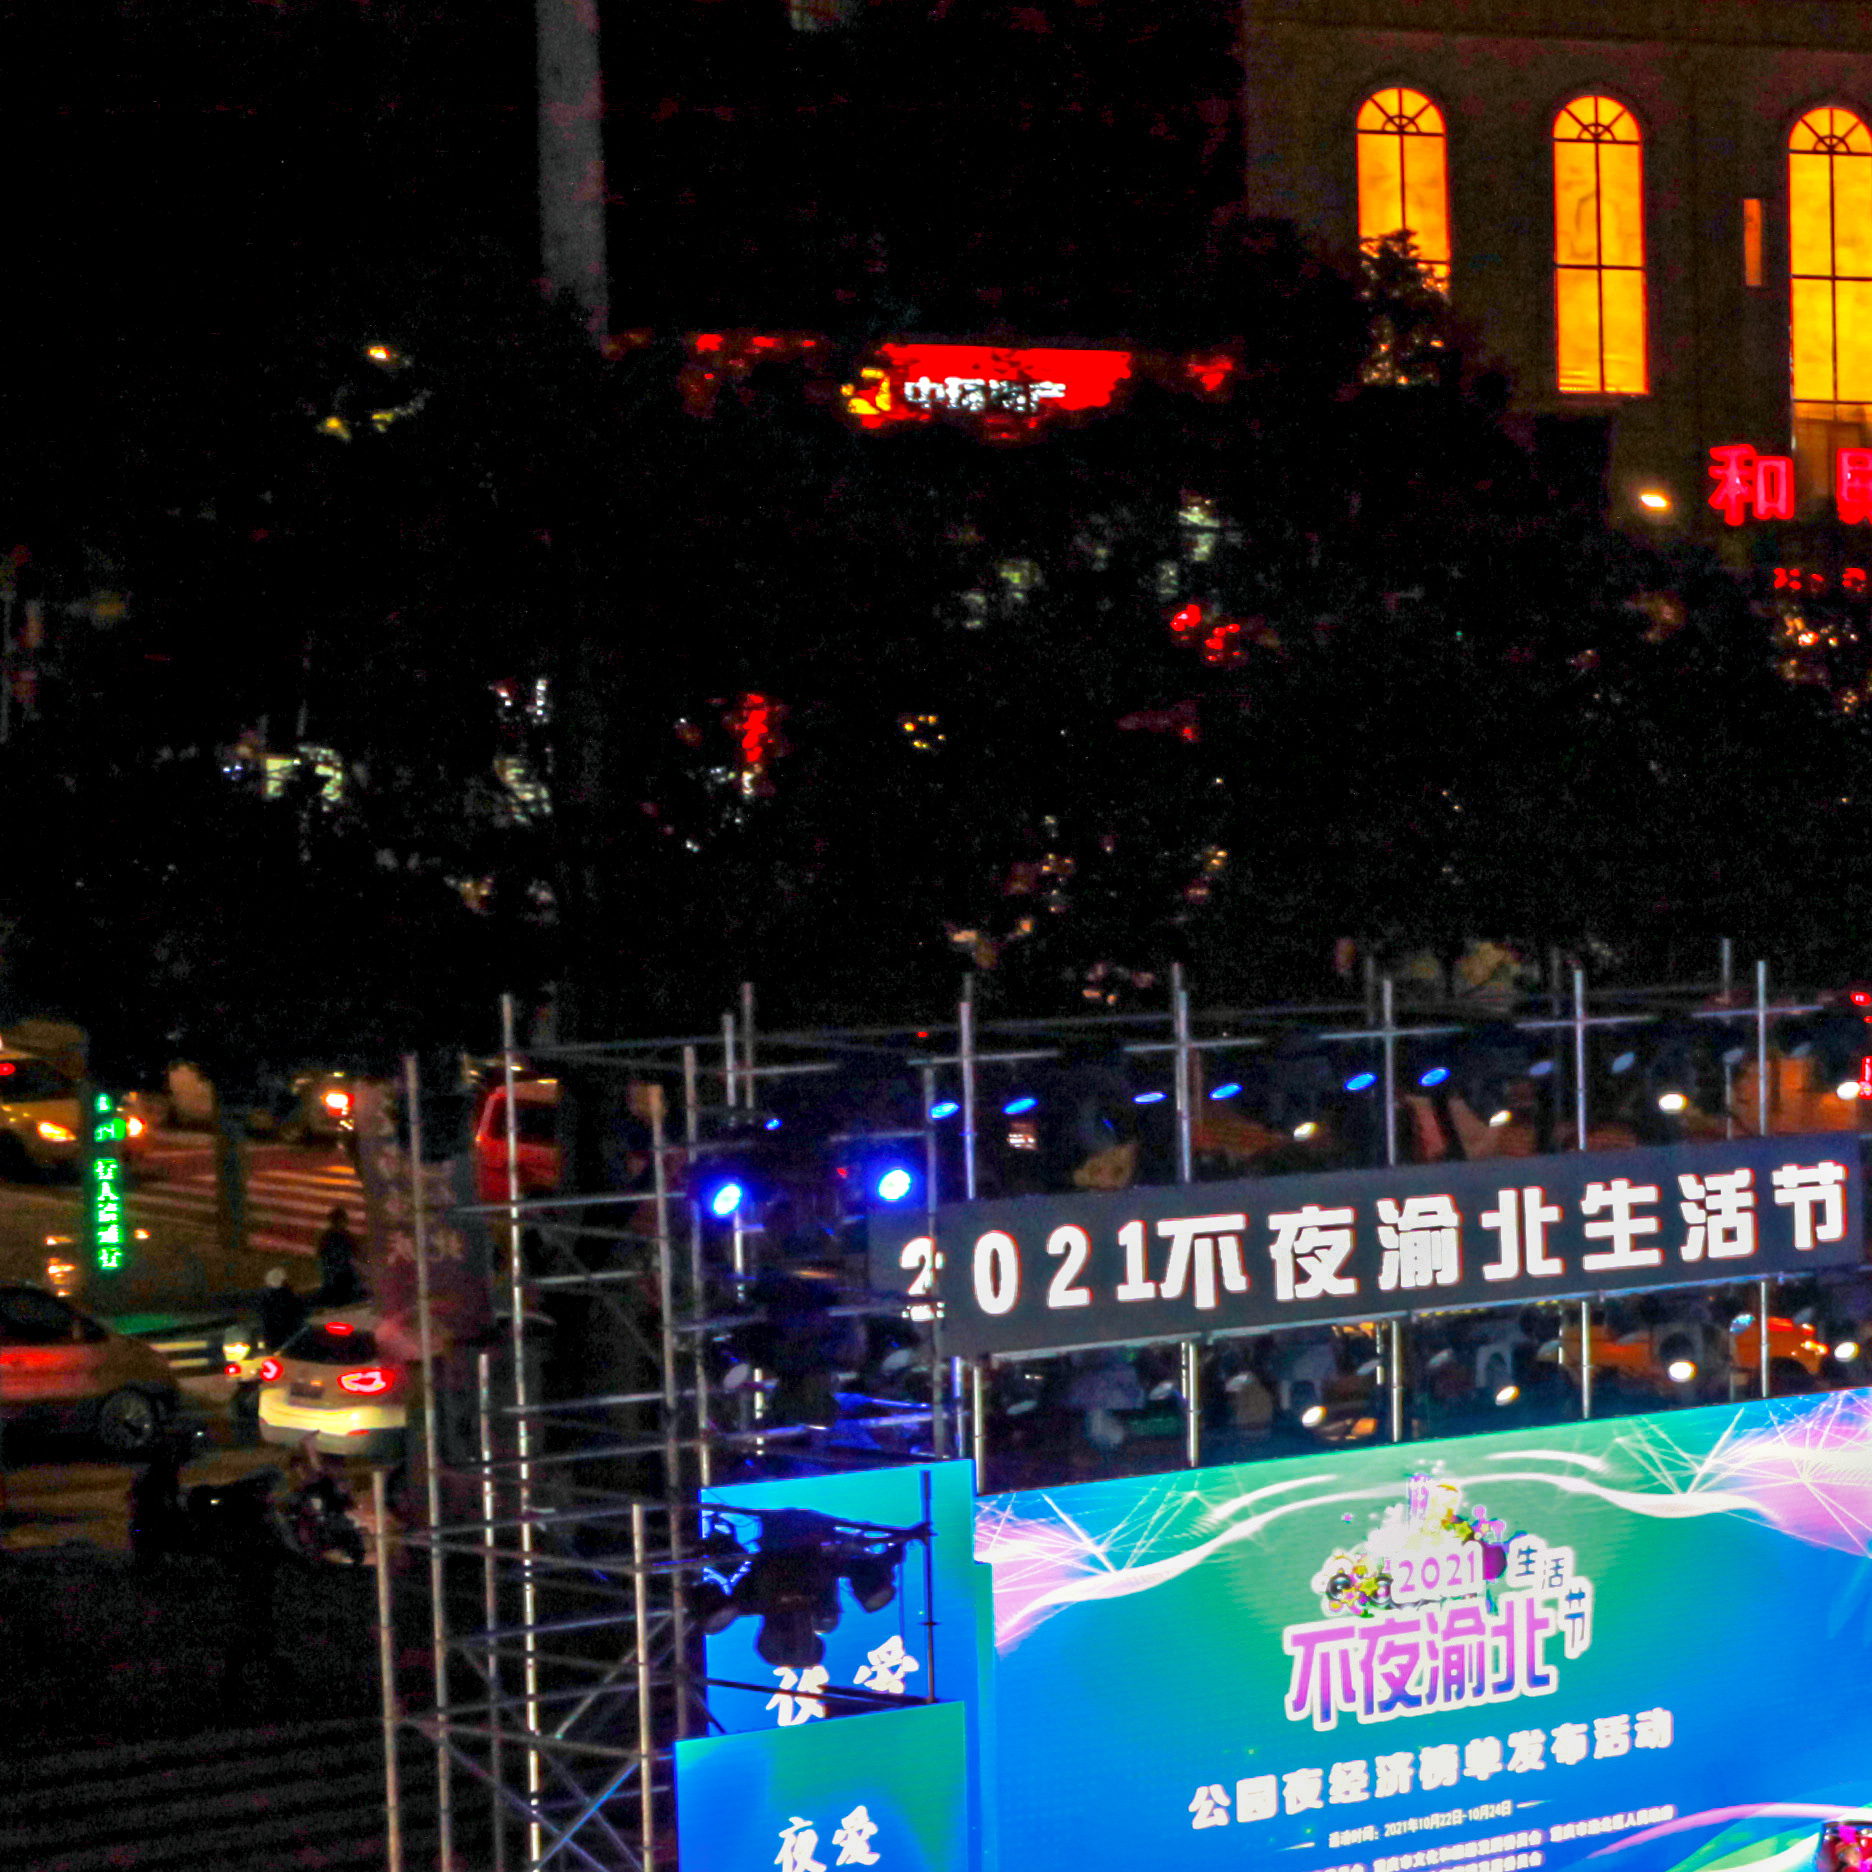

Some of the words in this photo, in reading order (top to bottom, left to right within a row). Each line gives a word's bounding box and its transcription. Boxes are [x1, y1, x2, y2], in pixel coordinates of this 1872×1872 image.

[900, 1160, 1848, 1315] 2021不夜渝北生活节
[1399, 1550, 1475, 1592] 2021
[1289, 1597, 1552, 1724] 不夜渝北
[1187, 1708, 1674, 1829] 公园夜经济榜单发布活动
